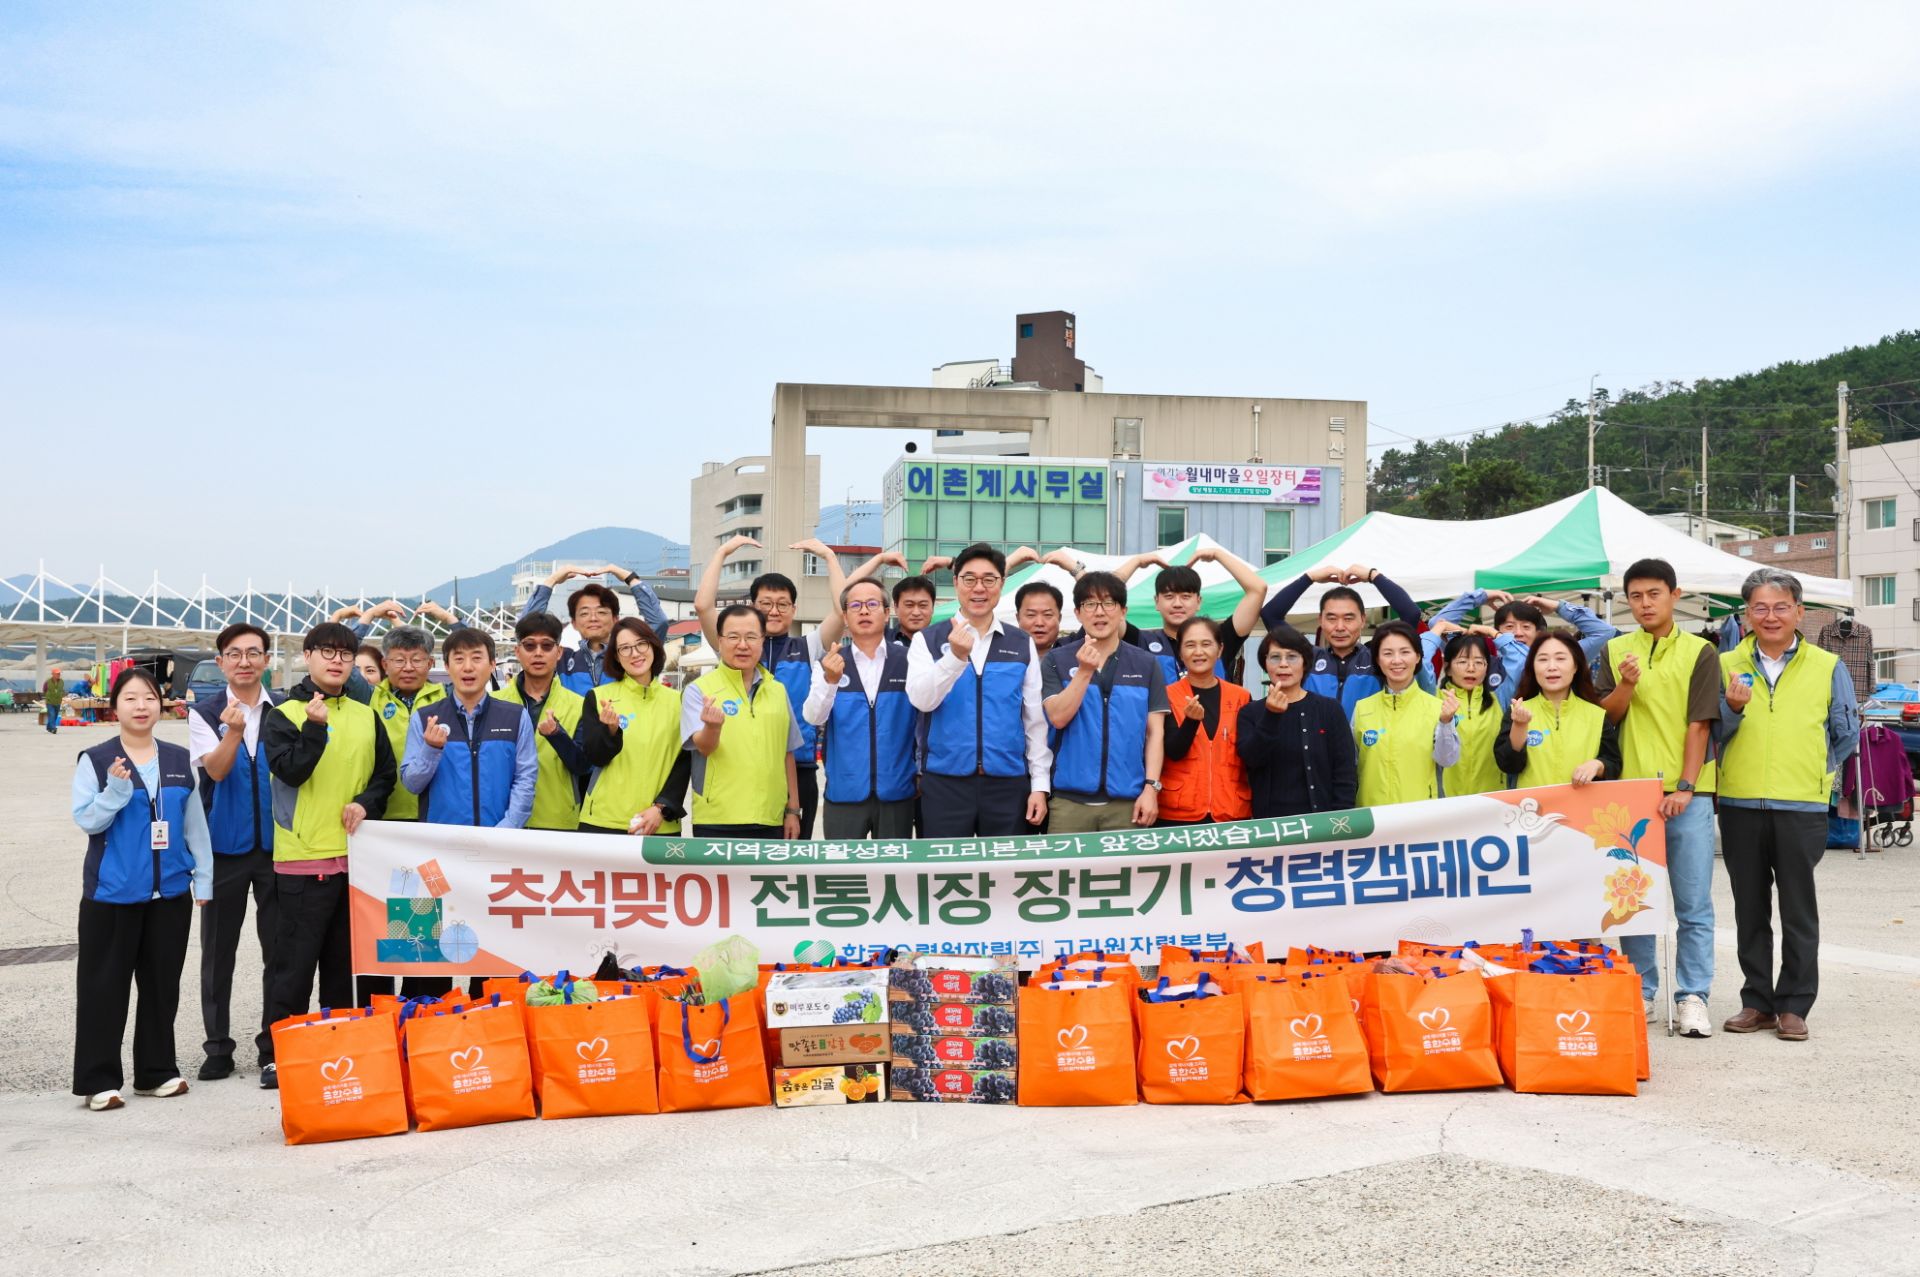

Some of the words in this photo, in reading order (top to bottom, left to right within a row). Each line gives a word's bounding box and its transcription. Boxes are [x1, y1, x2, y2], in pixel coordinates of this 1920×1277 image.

[908, 466, 1103, 499] 어촌계사무실
[1185, 466, 1240, 484] 월내마을
[1242, 469, 1296, 486] 오일장터
[704, 841, 912, 861] 지역경제활성화
[927, 836, 1086, 858] 고리본부가
[1101, 818, 1313, 853] 앞장서겠습니다
[488, 868, 729, 929] 추석맞이
[750, 871, 996, 928] 전통시장
[1225, 835, 1532, 912] 청렴캠페인
